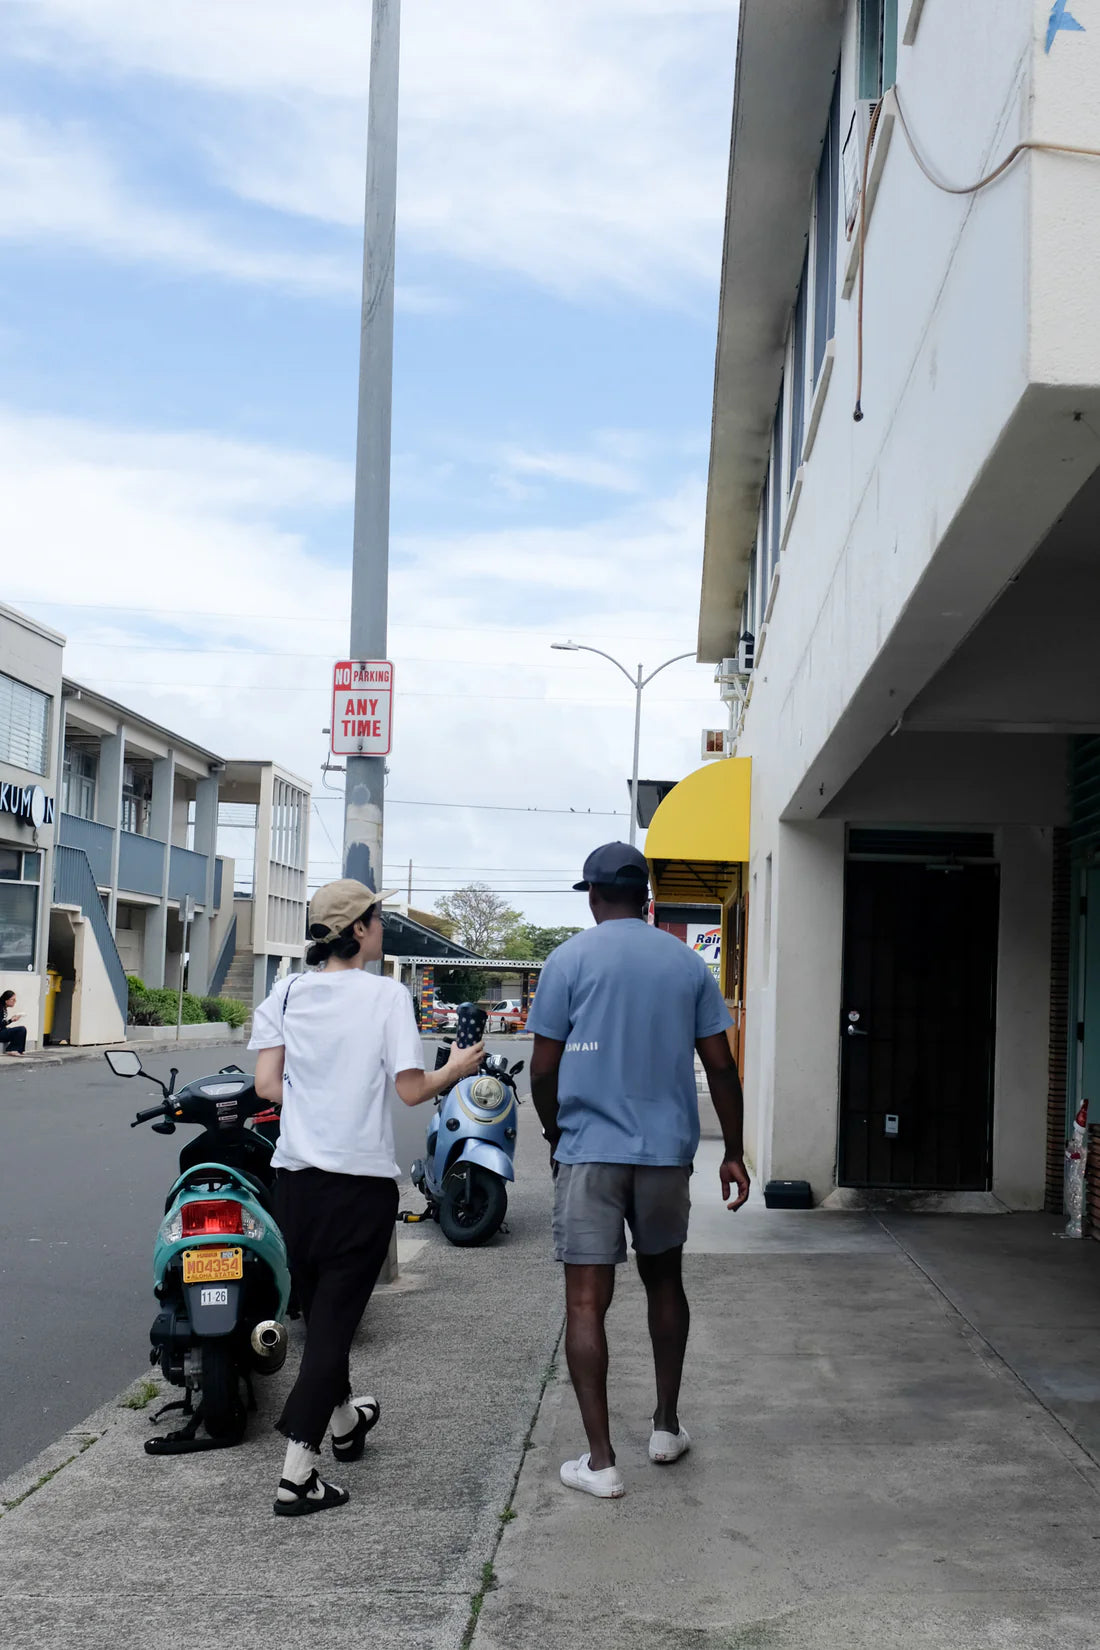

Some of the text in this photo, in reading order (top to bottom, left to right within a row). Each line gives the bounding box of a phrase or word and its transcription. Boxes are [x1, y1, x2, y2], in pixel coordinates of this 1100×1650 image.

[335, 668, 390, 686] NO PARKING
[345, 698, 379, 716] ANY
[341, 720, 381, 737] TIME
